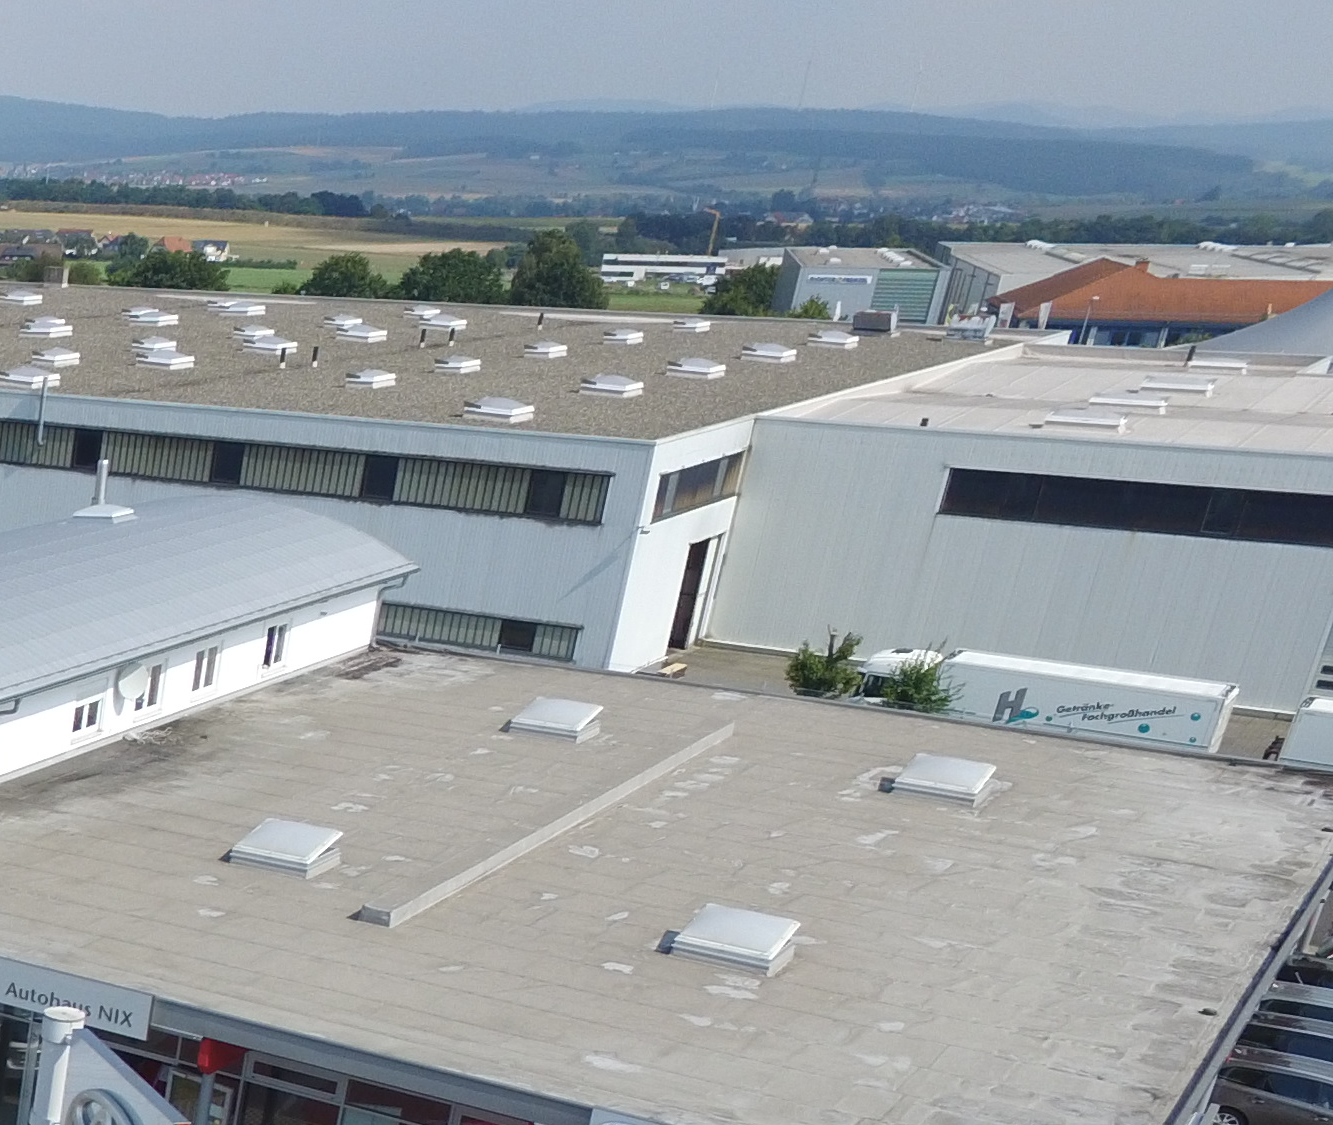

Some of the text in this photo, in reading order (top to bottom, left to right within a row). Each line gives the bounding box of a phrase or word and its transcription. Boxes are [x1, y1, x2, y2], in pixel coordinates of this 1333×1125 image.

[992, 688, 1028, 722] H
[1056, 701, 1115, 714] Getränke-
[1081, 706, 1177, 721] Fachgroßhandel
[98, 1004, 133, 1028] NIX
